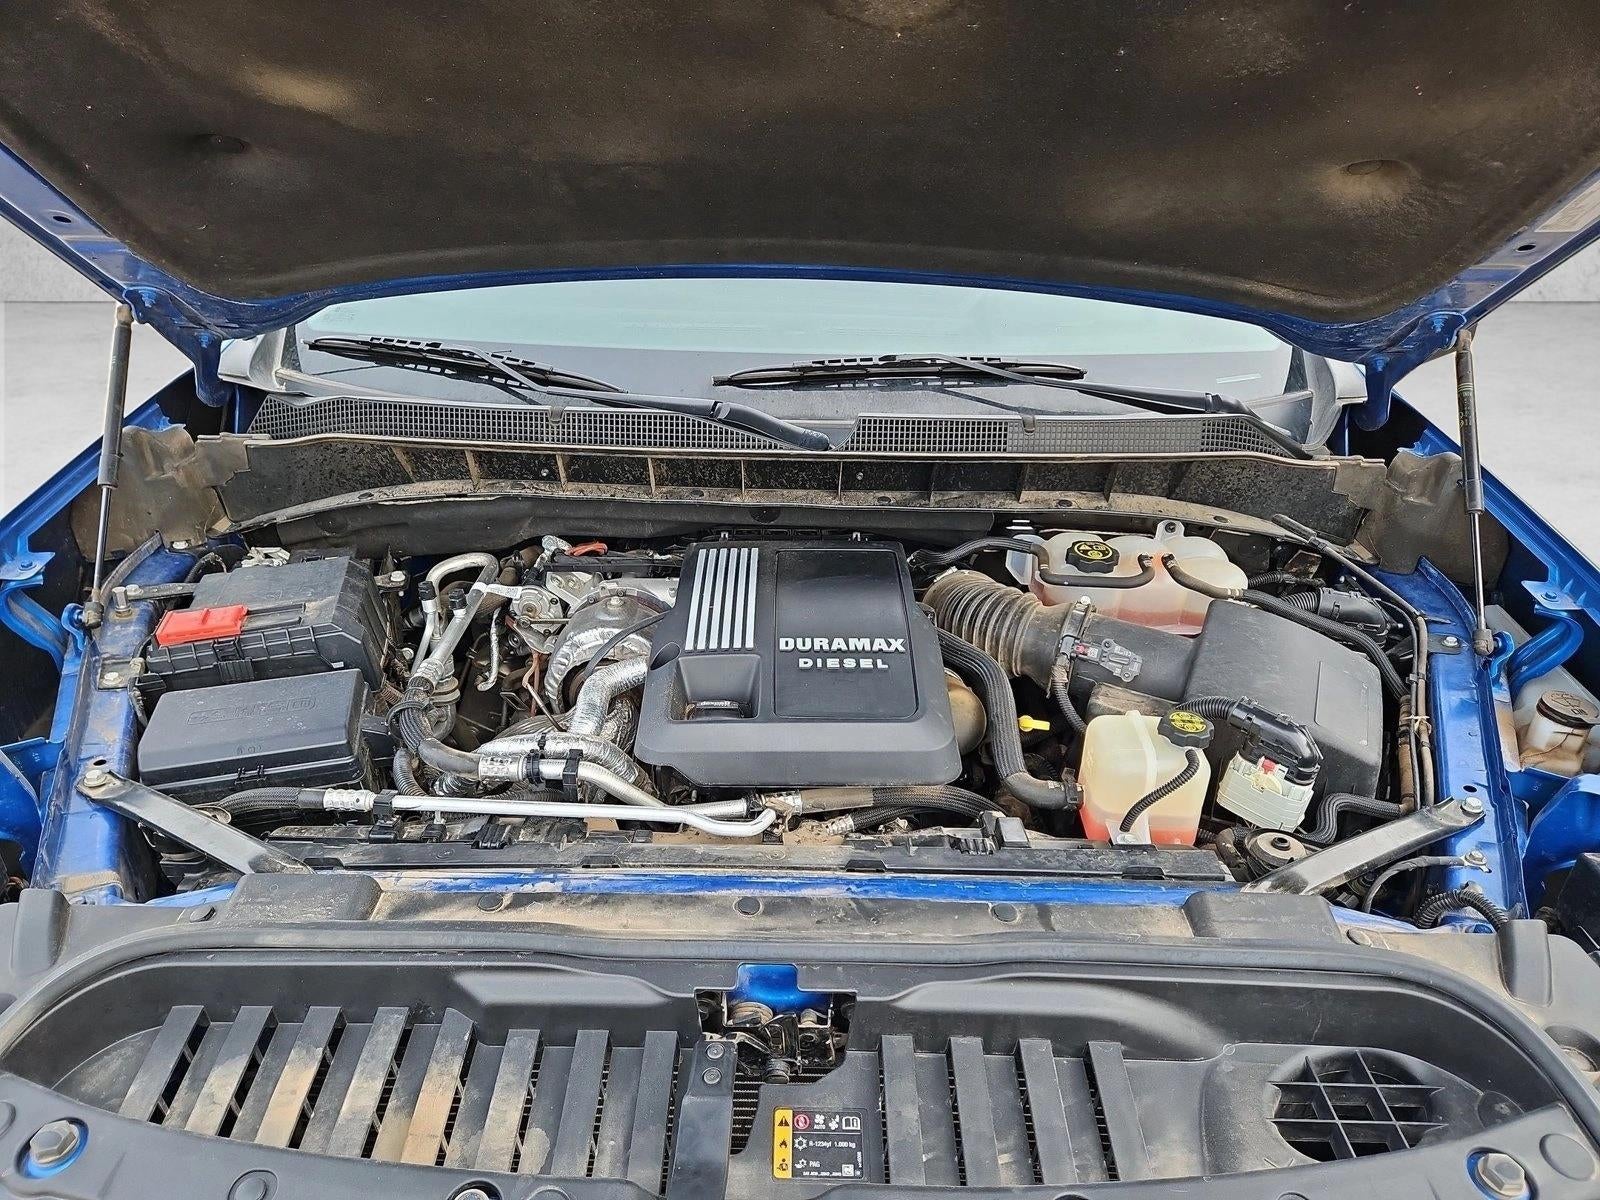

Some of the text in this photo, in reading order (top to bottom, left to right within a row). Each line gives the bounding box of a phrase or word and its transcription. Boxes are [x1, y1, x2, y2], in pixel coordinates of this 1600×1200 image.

[779, 637, 906, 652] DURAMAX
[798, 658, 889, 669] DIESEL
[848, 1141, 856, 1149] kg
[809, 1160, 820, 1168] PAG
